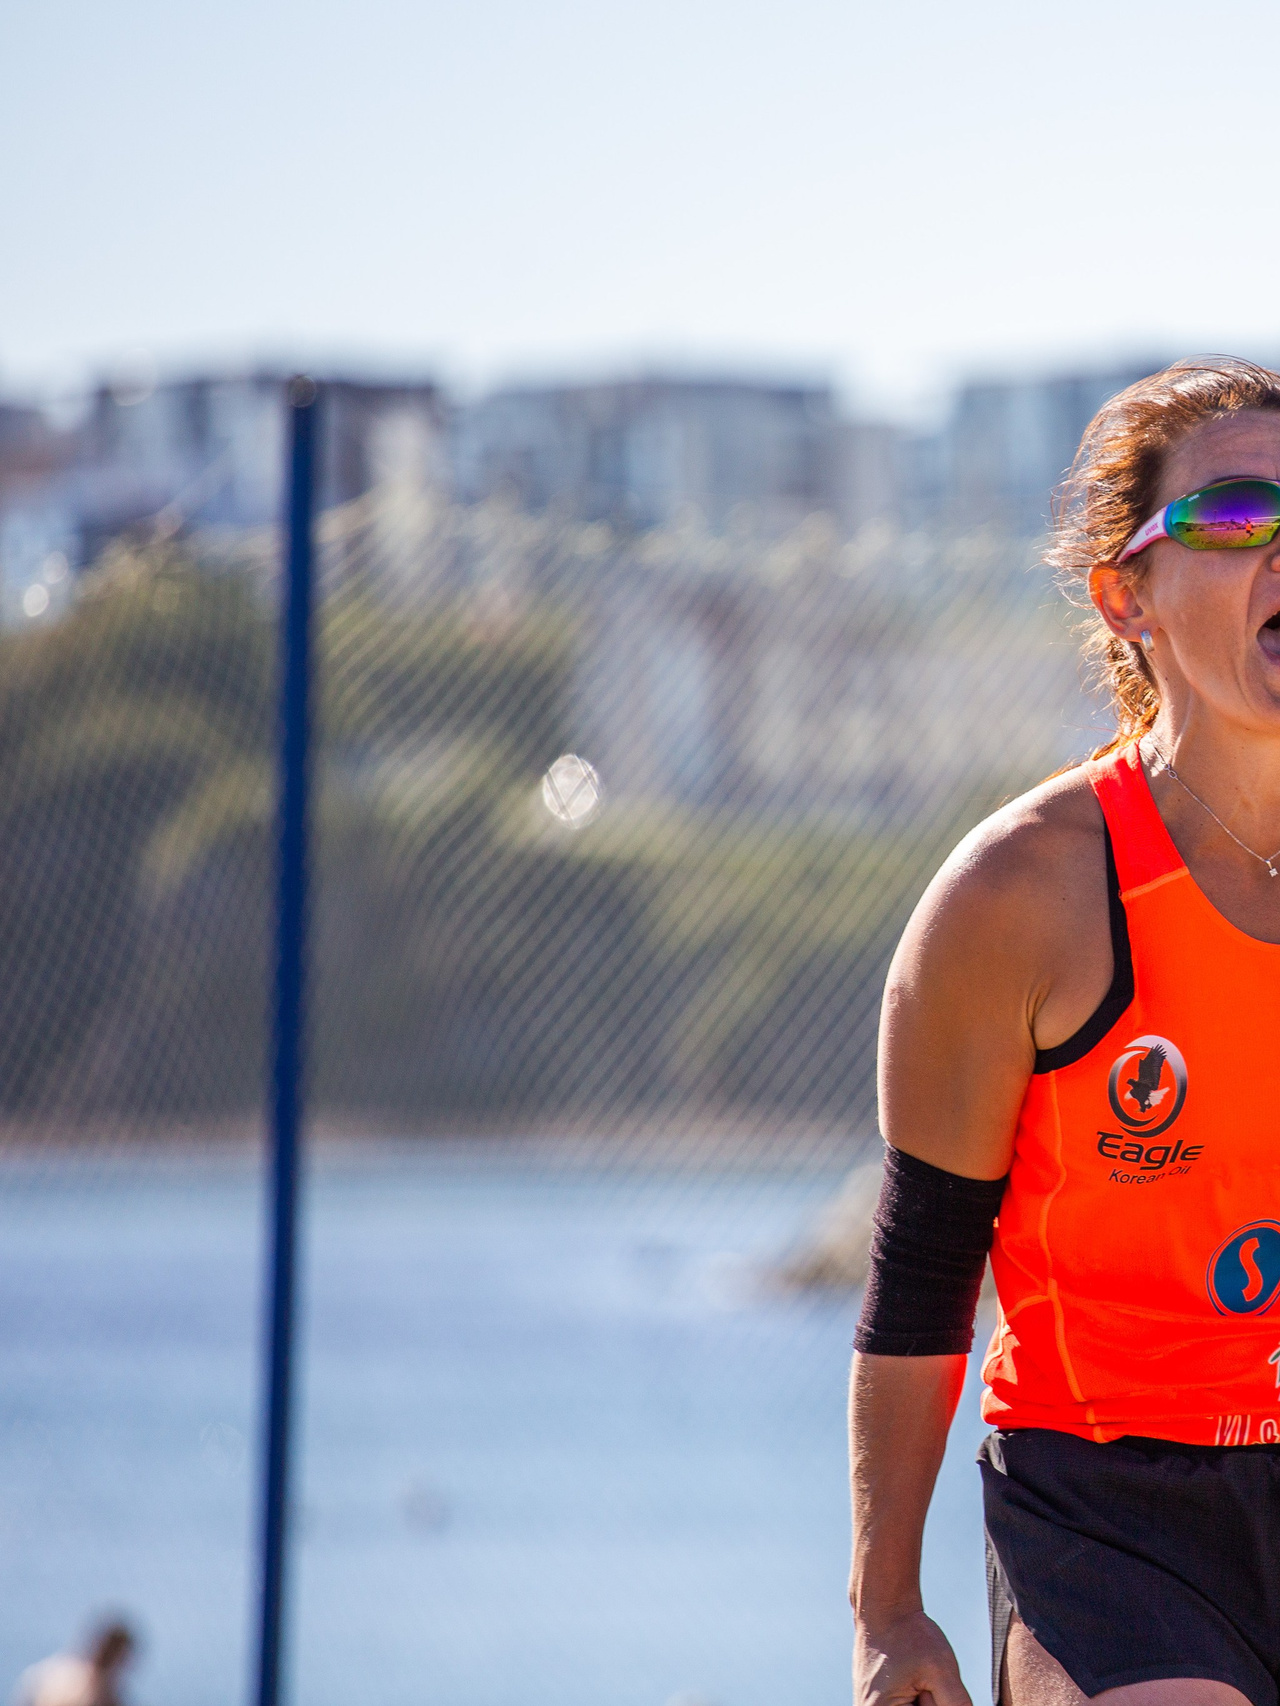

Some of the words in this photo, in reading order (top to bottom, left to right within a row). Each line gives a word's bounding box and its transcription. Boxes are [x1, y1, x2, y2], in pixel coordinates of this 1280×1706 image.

[1097, 1131, 1205, 1170] Eagle
[1108, 1169, 1165, 1184] Korean
[1168, 1165, 1191, 1176] Oil
